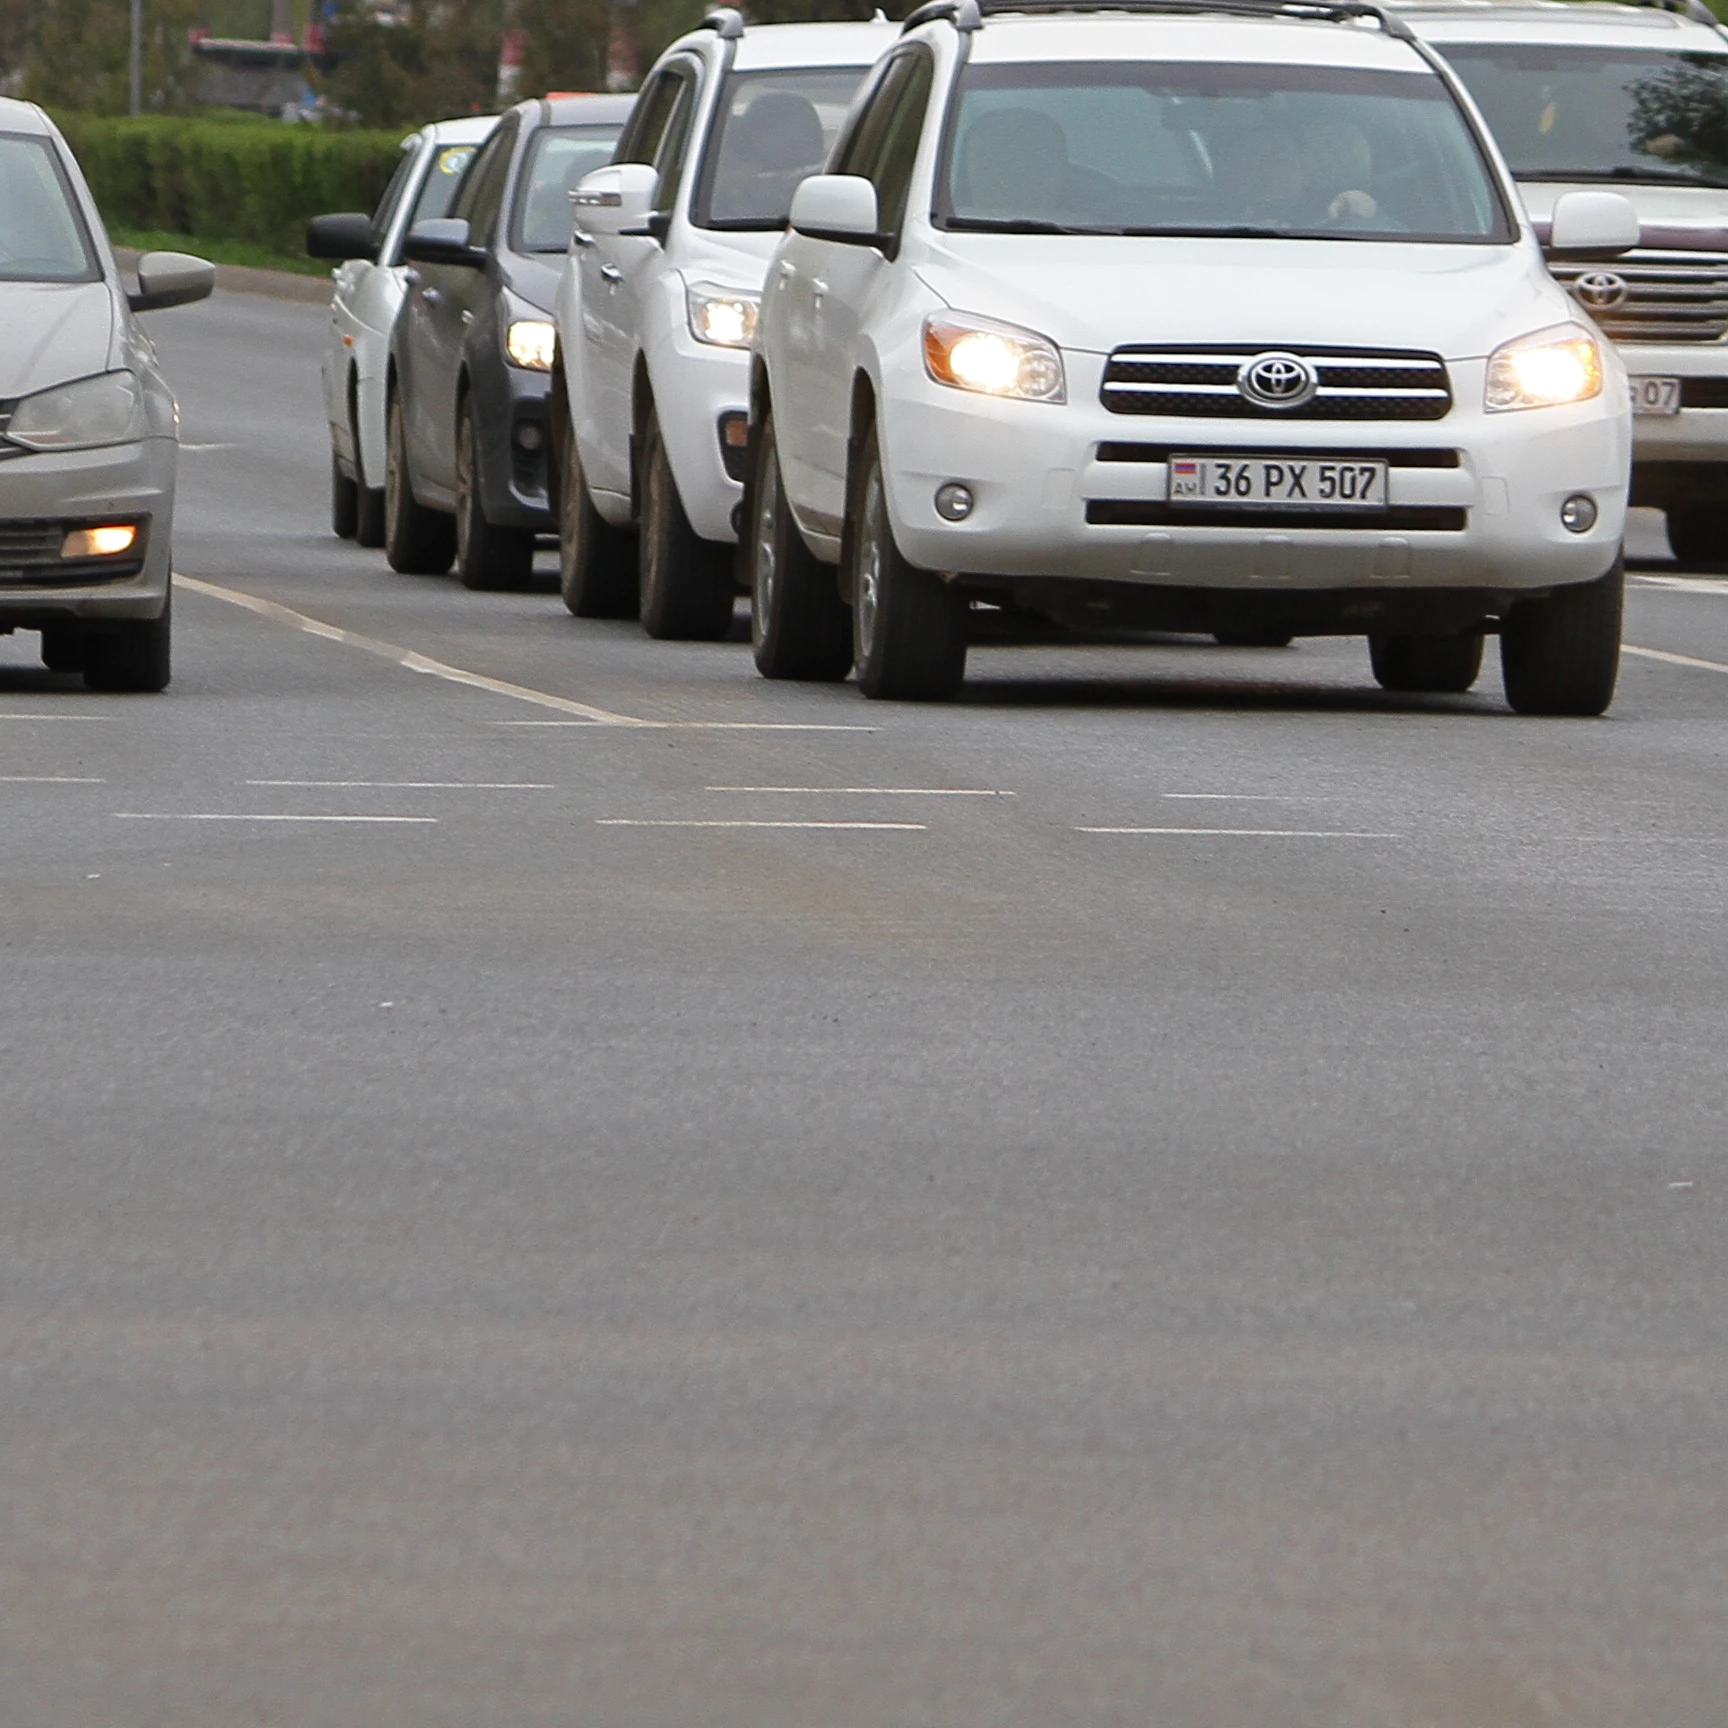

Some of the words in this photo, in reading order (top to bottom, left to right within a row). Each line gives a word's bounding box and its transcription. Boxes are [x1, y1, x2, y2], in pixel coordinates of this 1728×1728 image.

[1645, 380, 1676, 405] 07
[1213, 463, 1251, 497] 36
[1263, 464, 1308, 498] PX
[1318, 466, 1376, 500] 507
